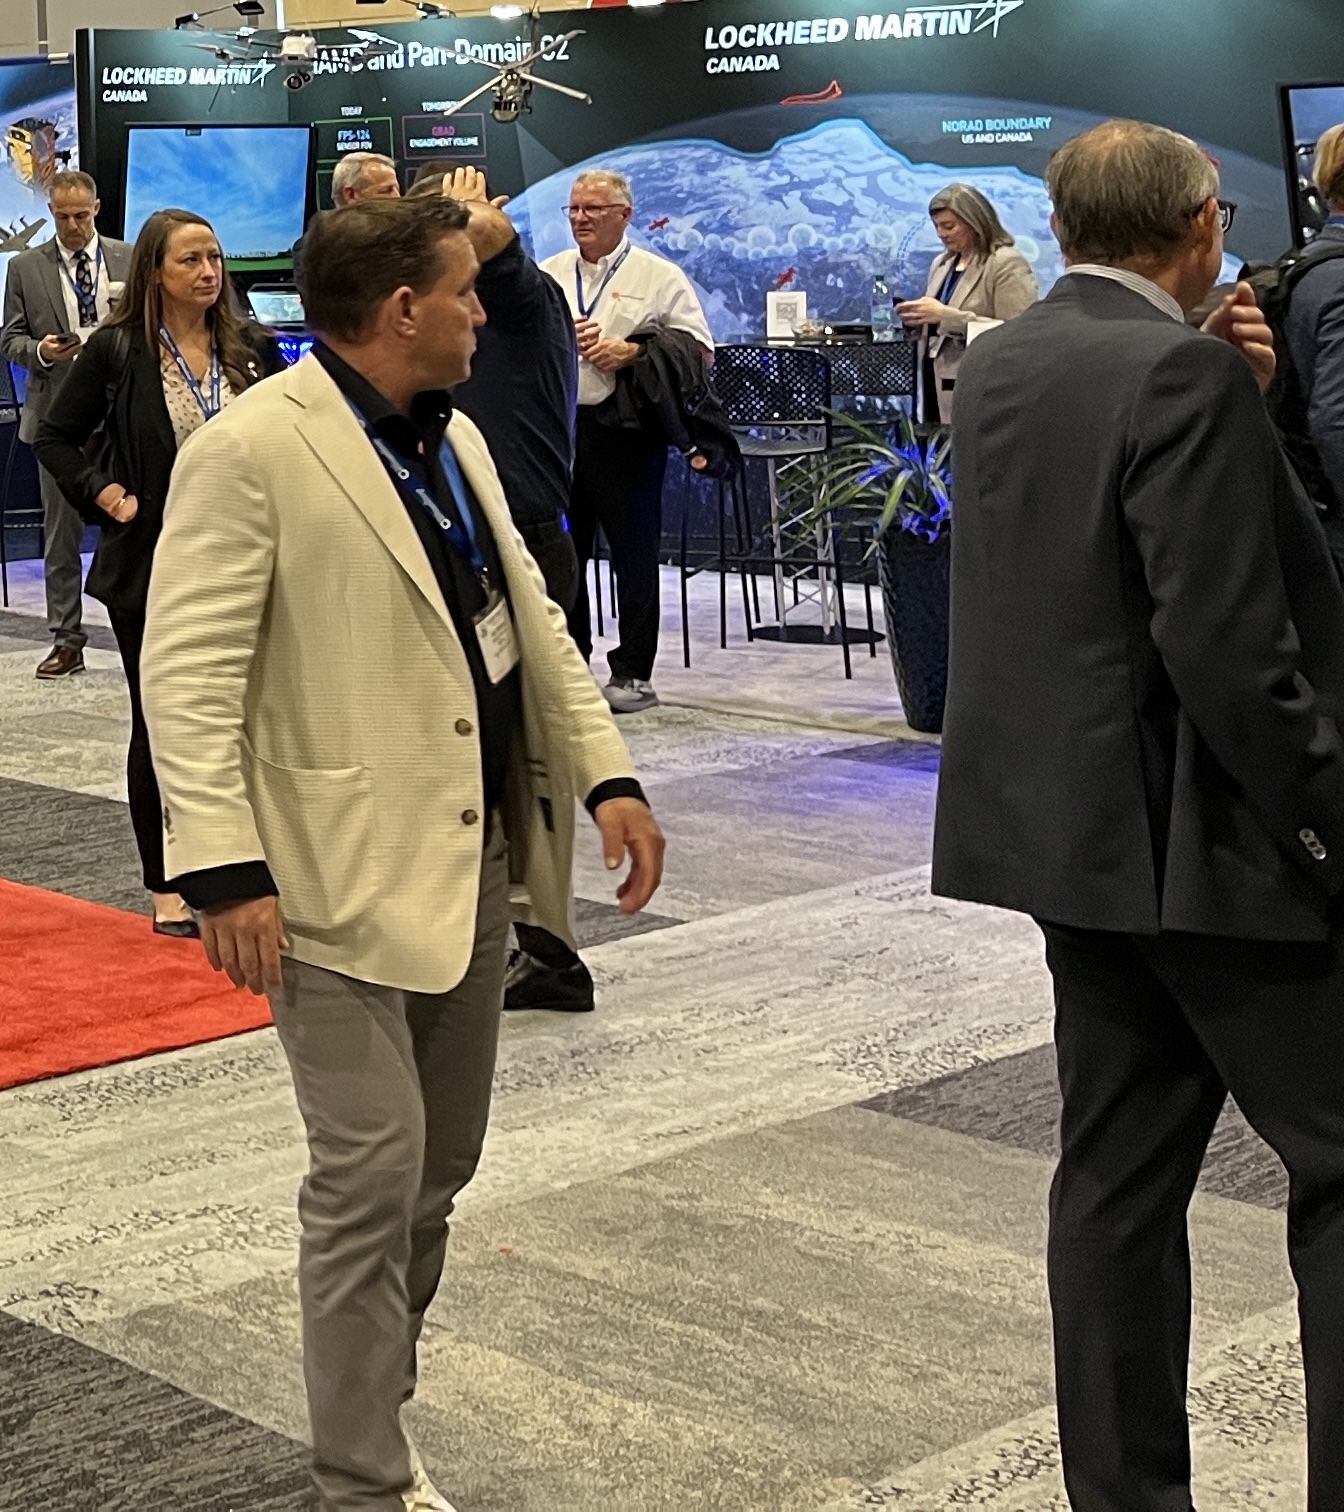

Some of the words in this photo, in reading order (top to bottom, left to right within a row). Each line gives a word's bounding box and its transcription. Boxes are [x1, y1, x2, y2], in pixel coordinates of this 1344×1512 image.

[705, 16, 849, 50] LOCKHEED
[855, 9, 973, 41] MARTIN
[408, 38, 532, 67] Pan-Domain
[540, 34, 570, 61] C2
[706, 54, 781, 74] CANADA
[102, 67, 187, 85] LOCKHEED
[189, 67, 252, 85] MARTIN
[102, 90, 148, 102] CANADA
[942, 119, 983, 133] NORAD
[985, 116, 1052, 131] BOUNDARY
[961, 133, 974, 144] US
[975, 133, 994, 143] AND
[995, 132, 1033, 143] CANADA
